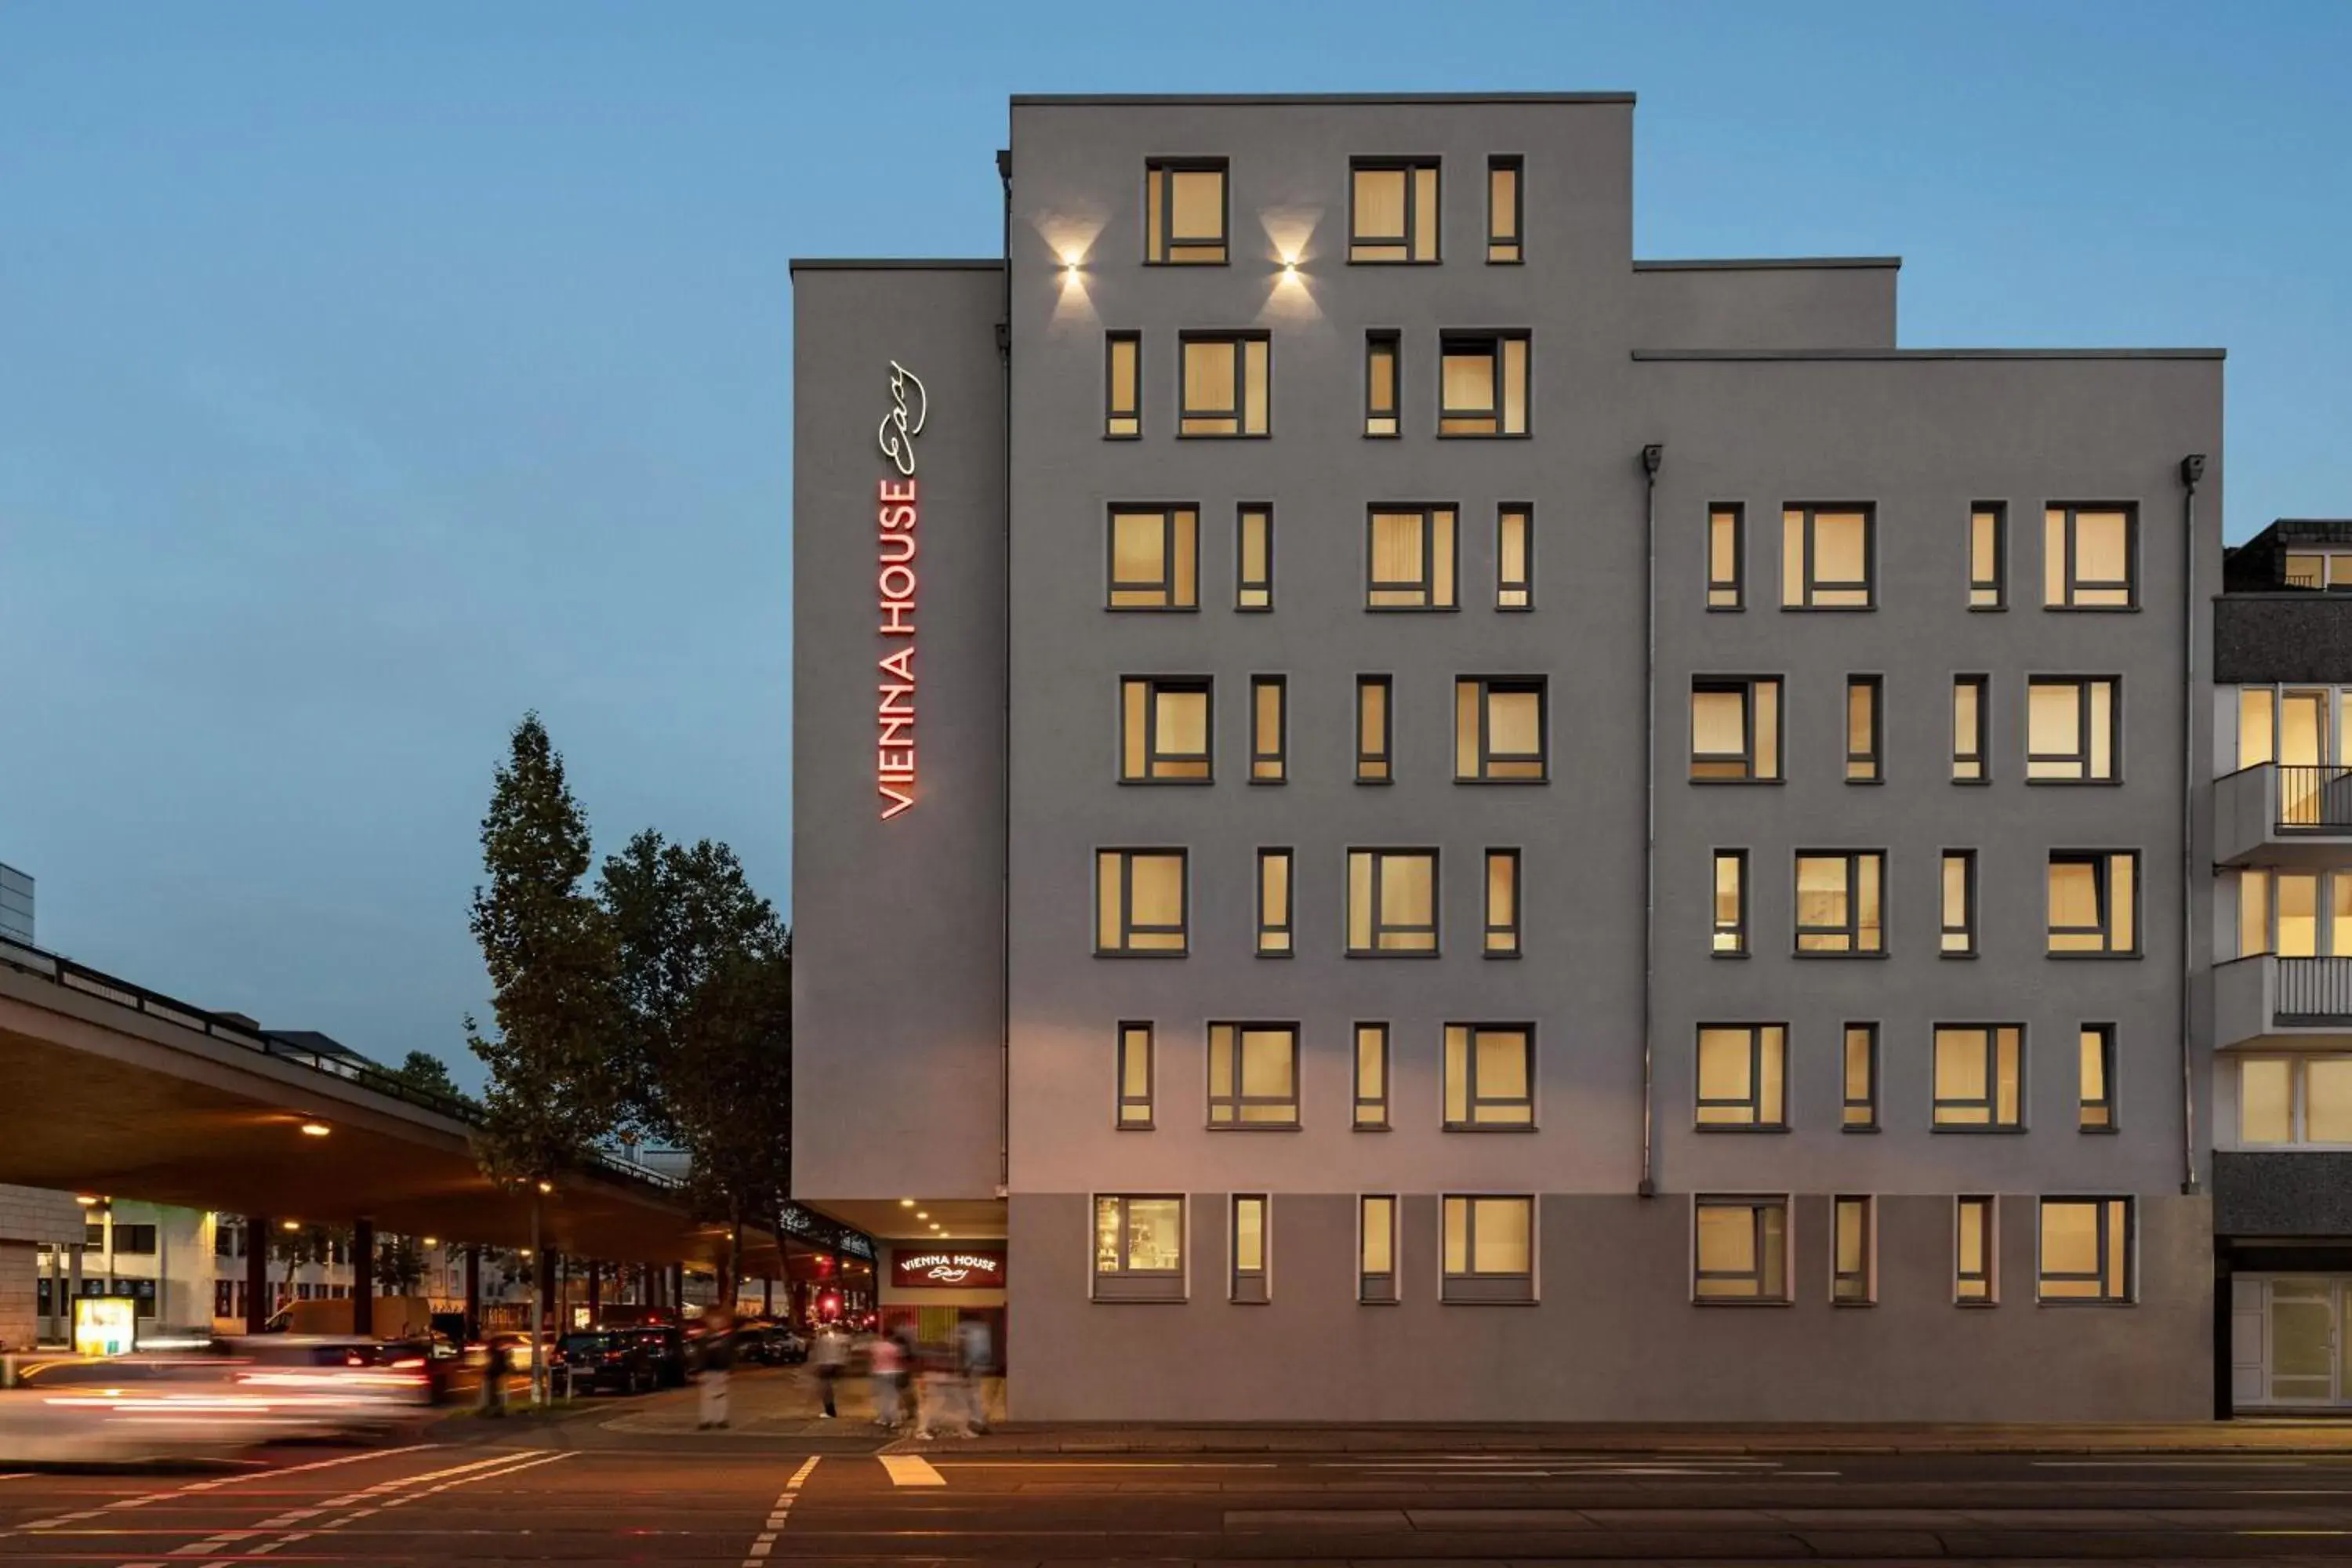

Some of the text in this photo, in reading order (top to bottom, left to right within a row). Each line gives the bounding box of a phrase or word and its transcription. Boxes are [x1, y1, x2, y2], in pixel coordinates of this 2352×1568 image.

[878, 361, 927, 821] VIENNA HOUSE Easy
[901, 1254, 996, 1272] VIENNA HOUSE
